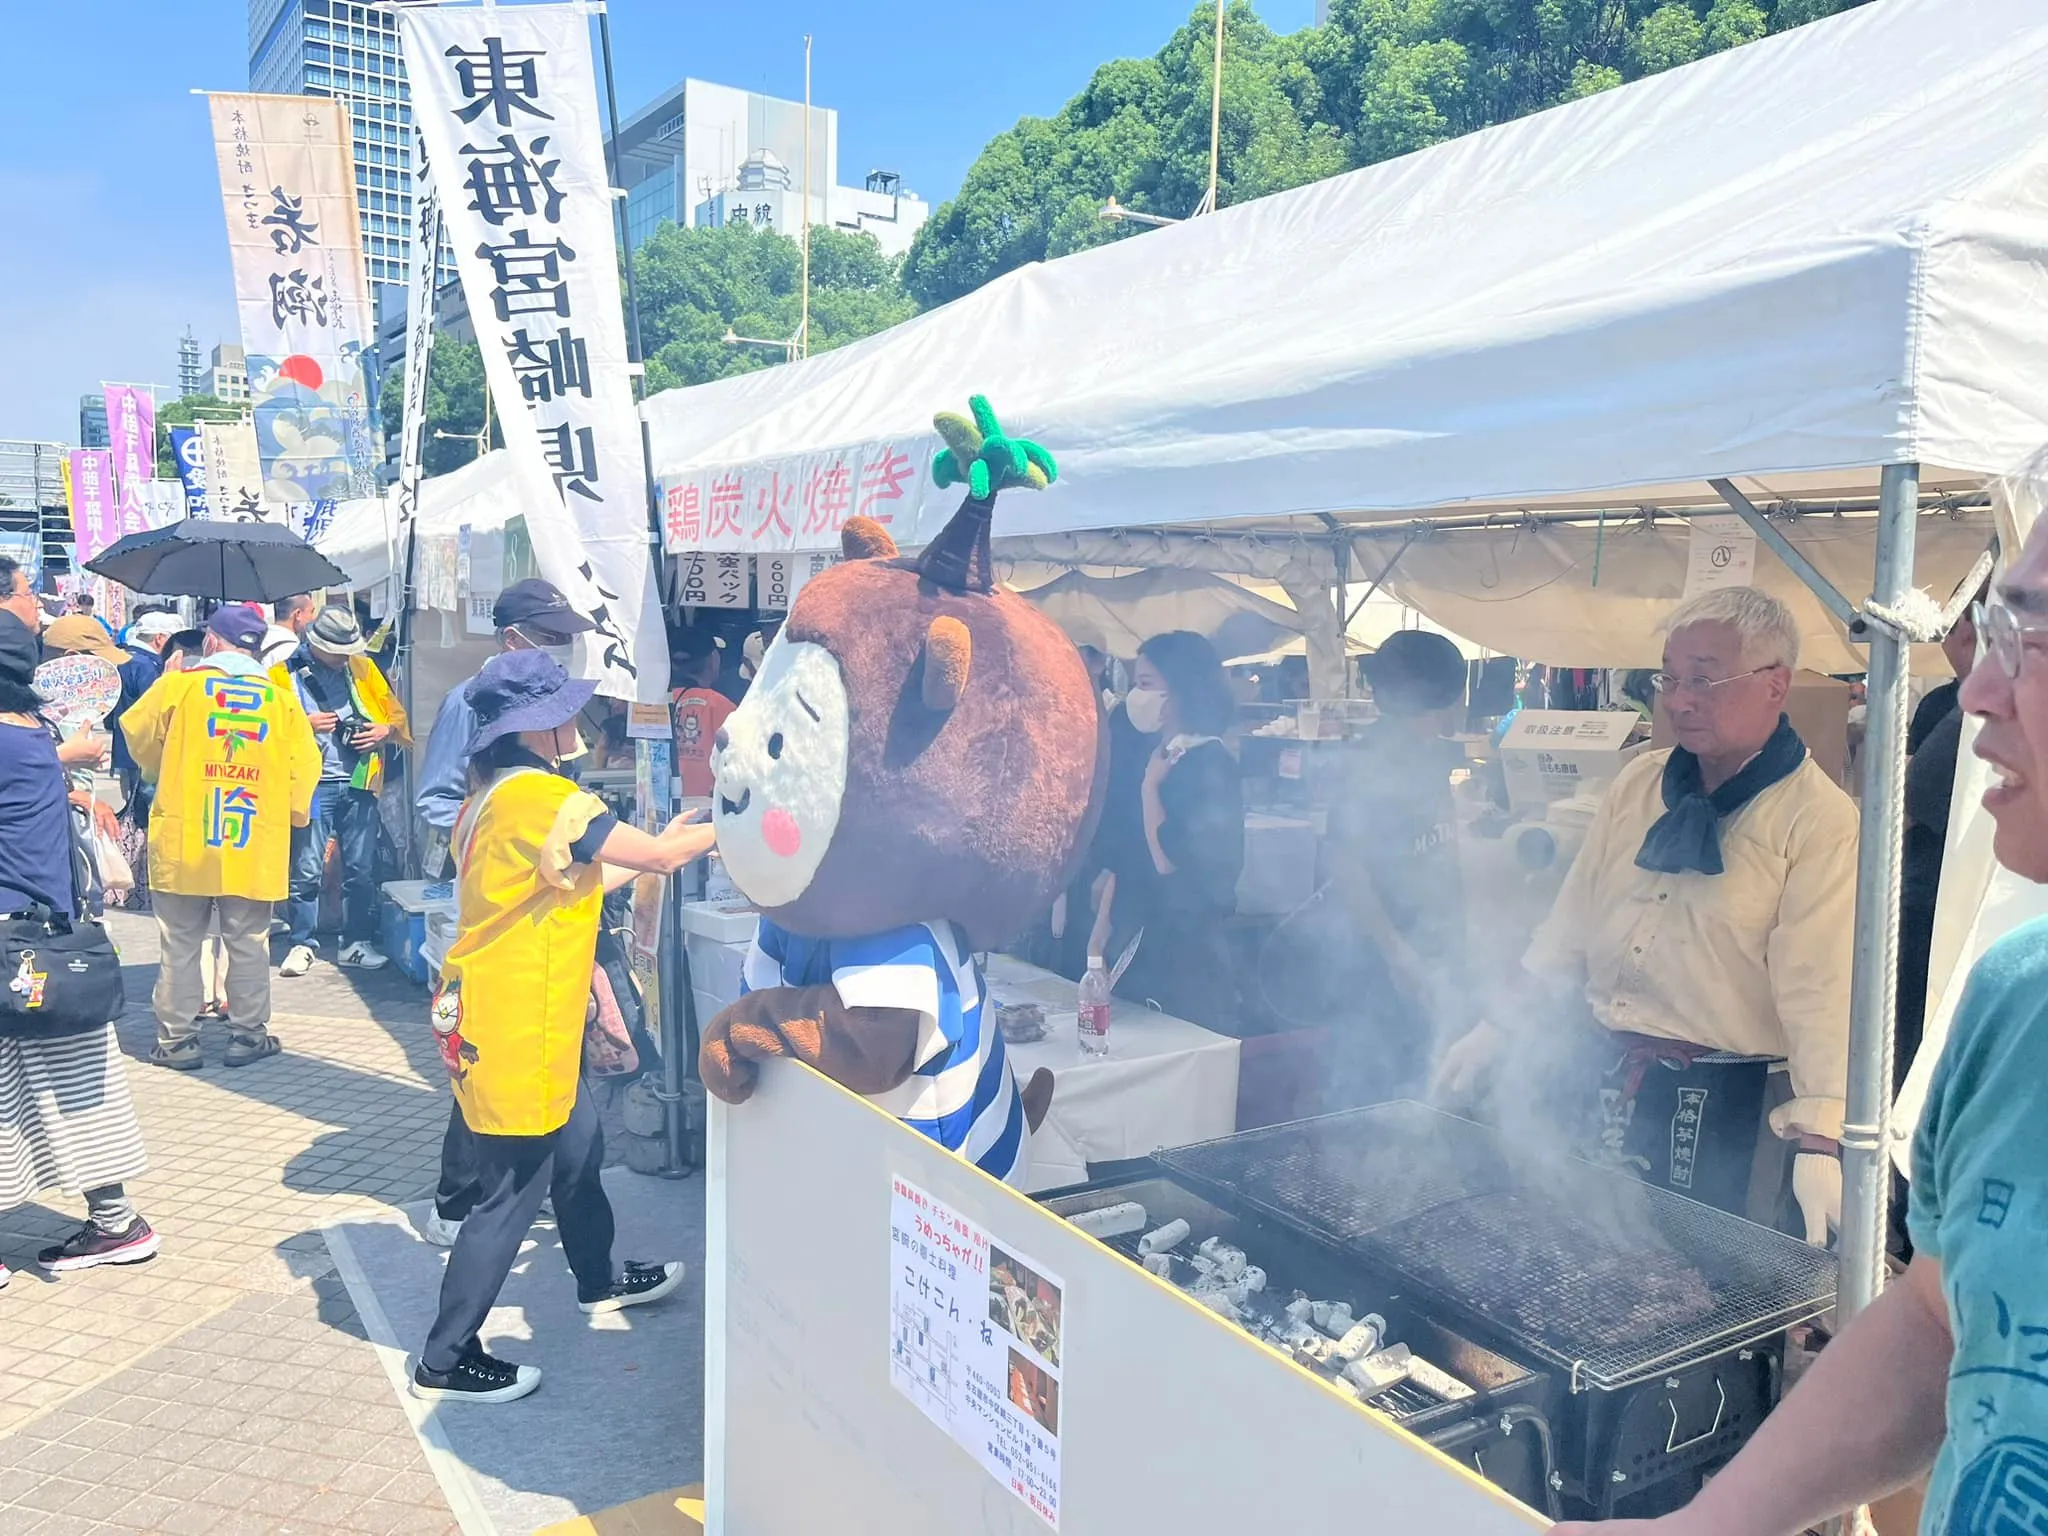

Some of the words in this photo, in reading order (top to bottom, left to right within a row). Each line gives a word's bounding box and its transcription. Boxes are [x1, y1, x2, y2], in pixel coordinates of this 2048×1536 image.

[667, 446, 915, 545] 鶏炭火焼き
[716, 550, 741, 604] 空パック
[768, 559, 788, 607] 600円
